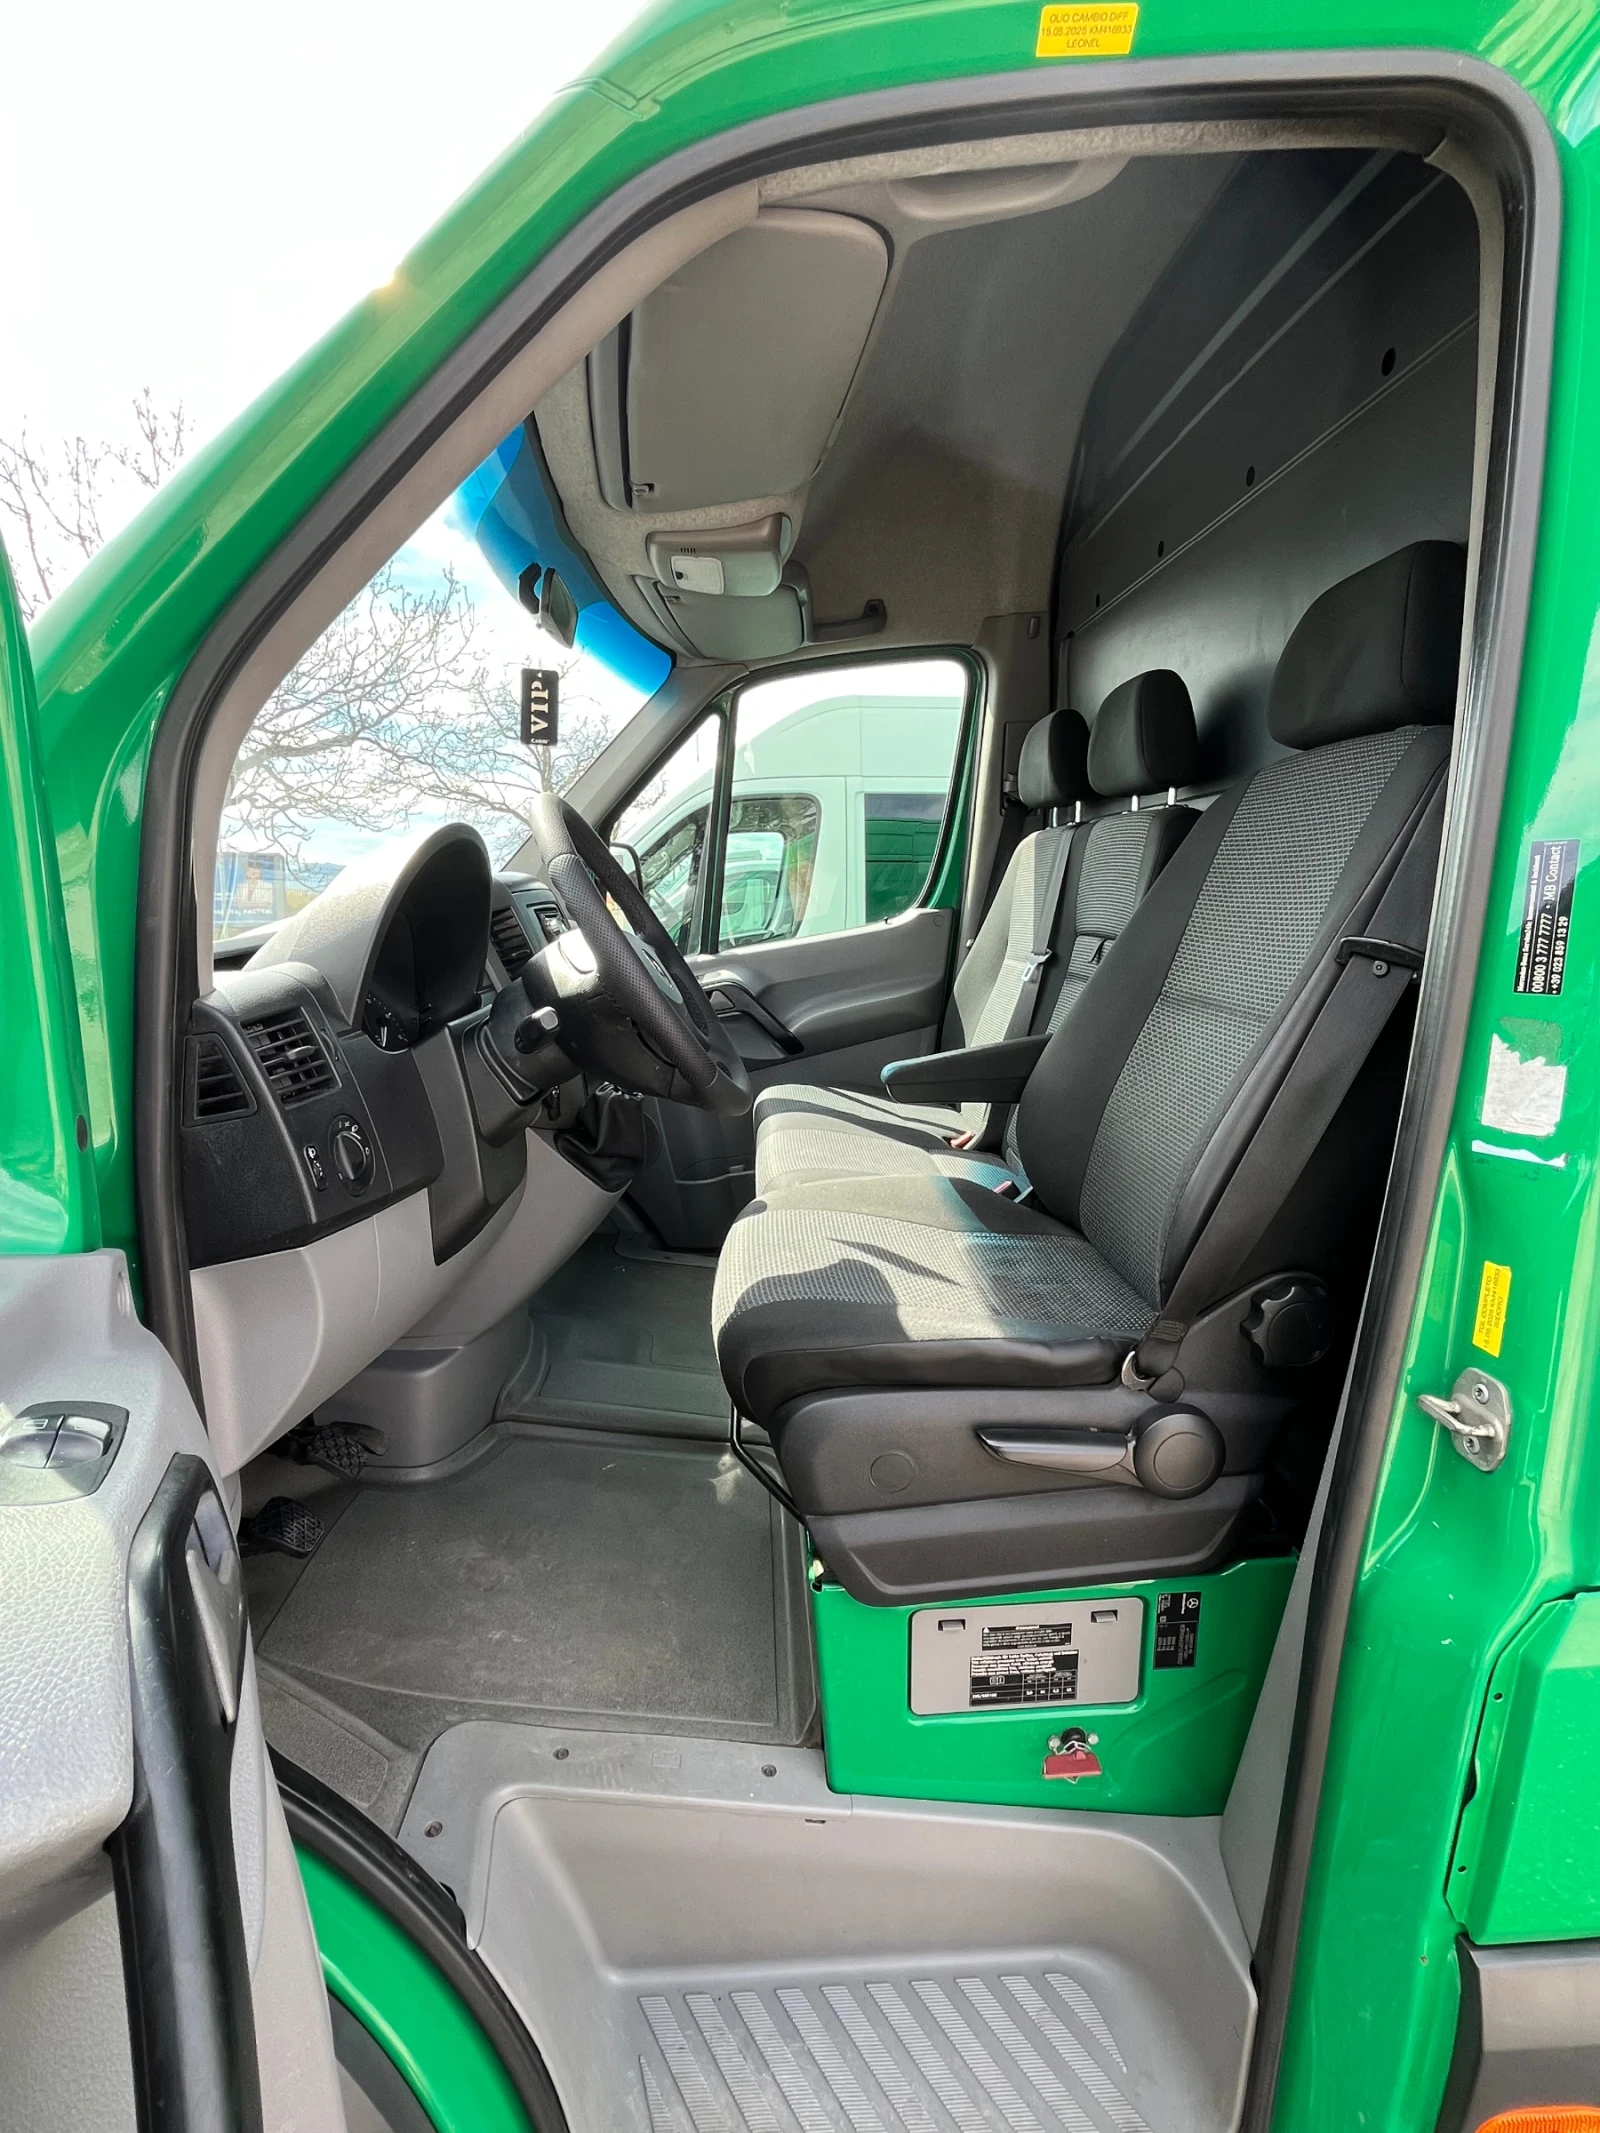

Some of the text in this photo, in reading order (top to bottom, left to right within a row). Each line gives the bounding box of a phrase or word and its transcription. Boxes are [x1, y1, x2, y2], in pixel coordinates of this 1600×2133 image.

[1066, 38, 1100, 49] LEONEL
[530, 680, 549, 734] VIP
[1545, 845, 1562, 882] Contact
[1542, 884, 1557, 901] MB
[1538, 912, 1553, 936] 7777
[1536, 937, 1550, 955] 777
[1551, 915, 1569, 989] +39 023 859 13 29
[1531, 964, 1547, 993] 00800
